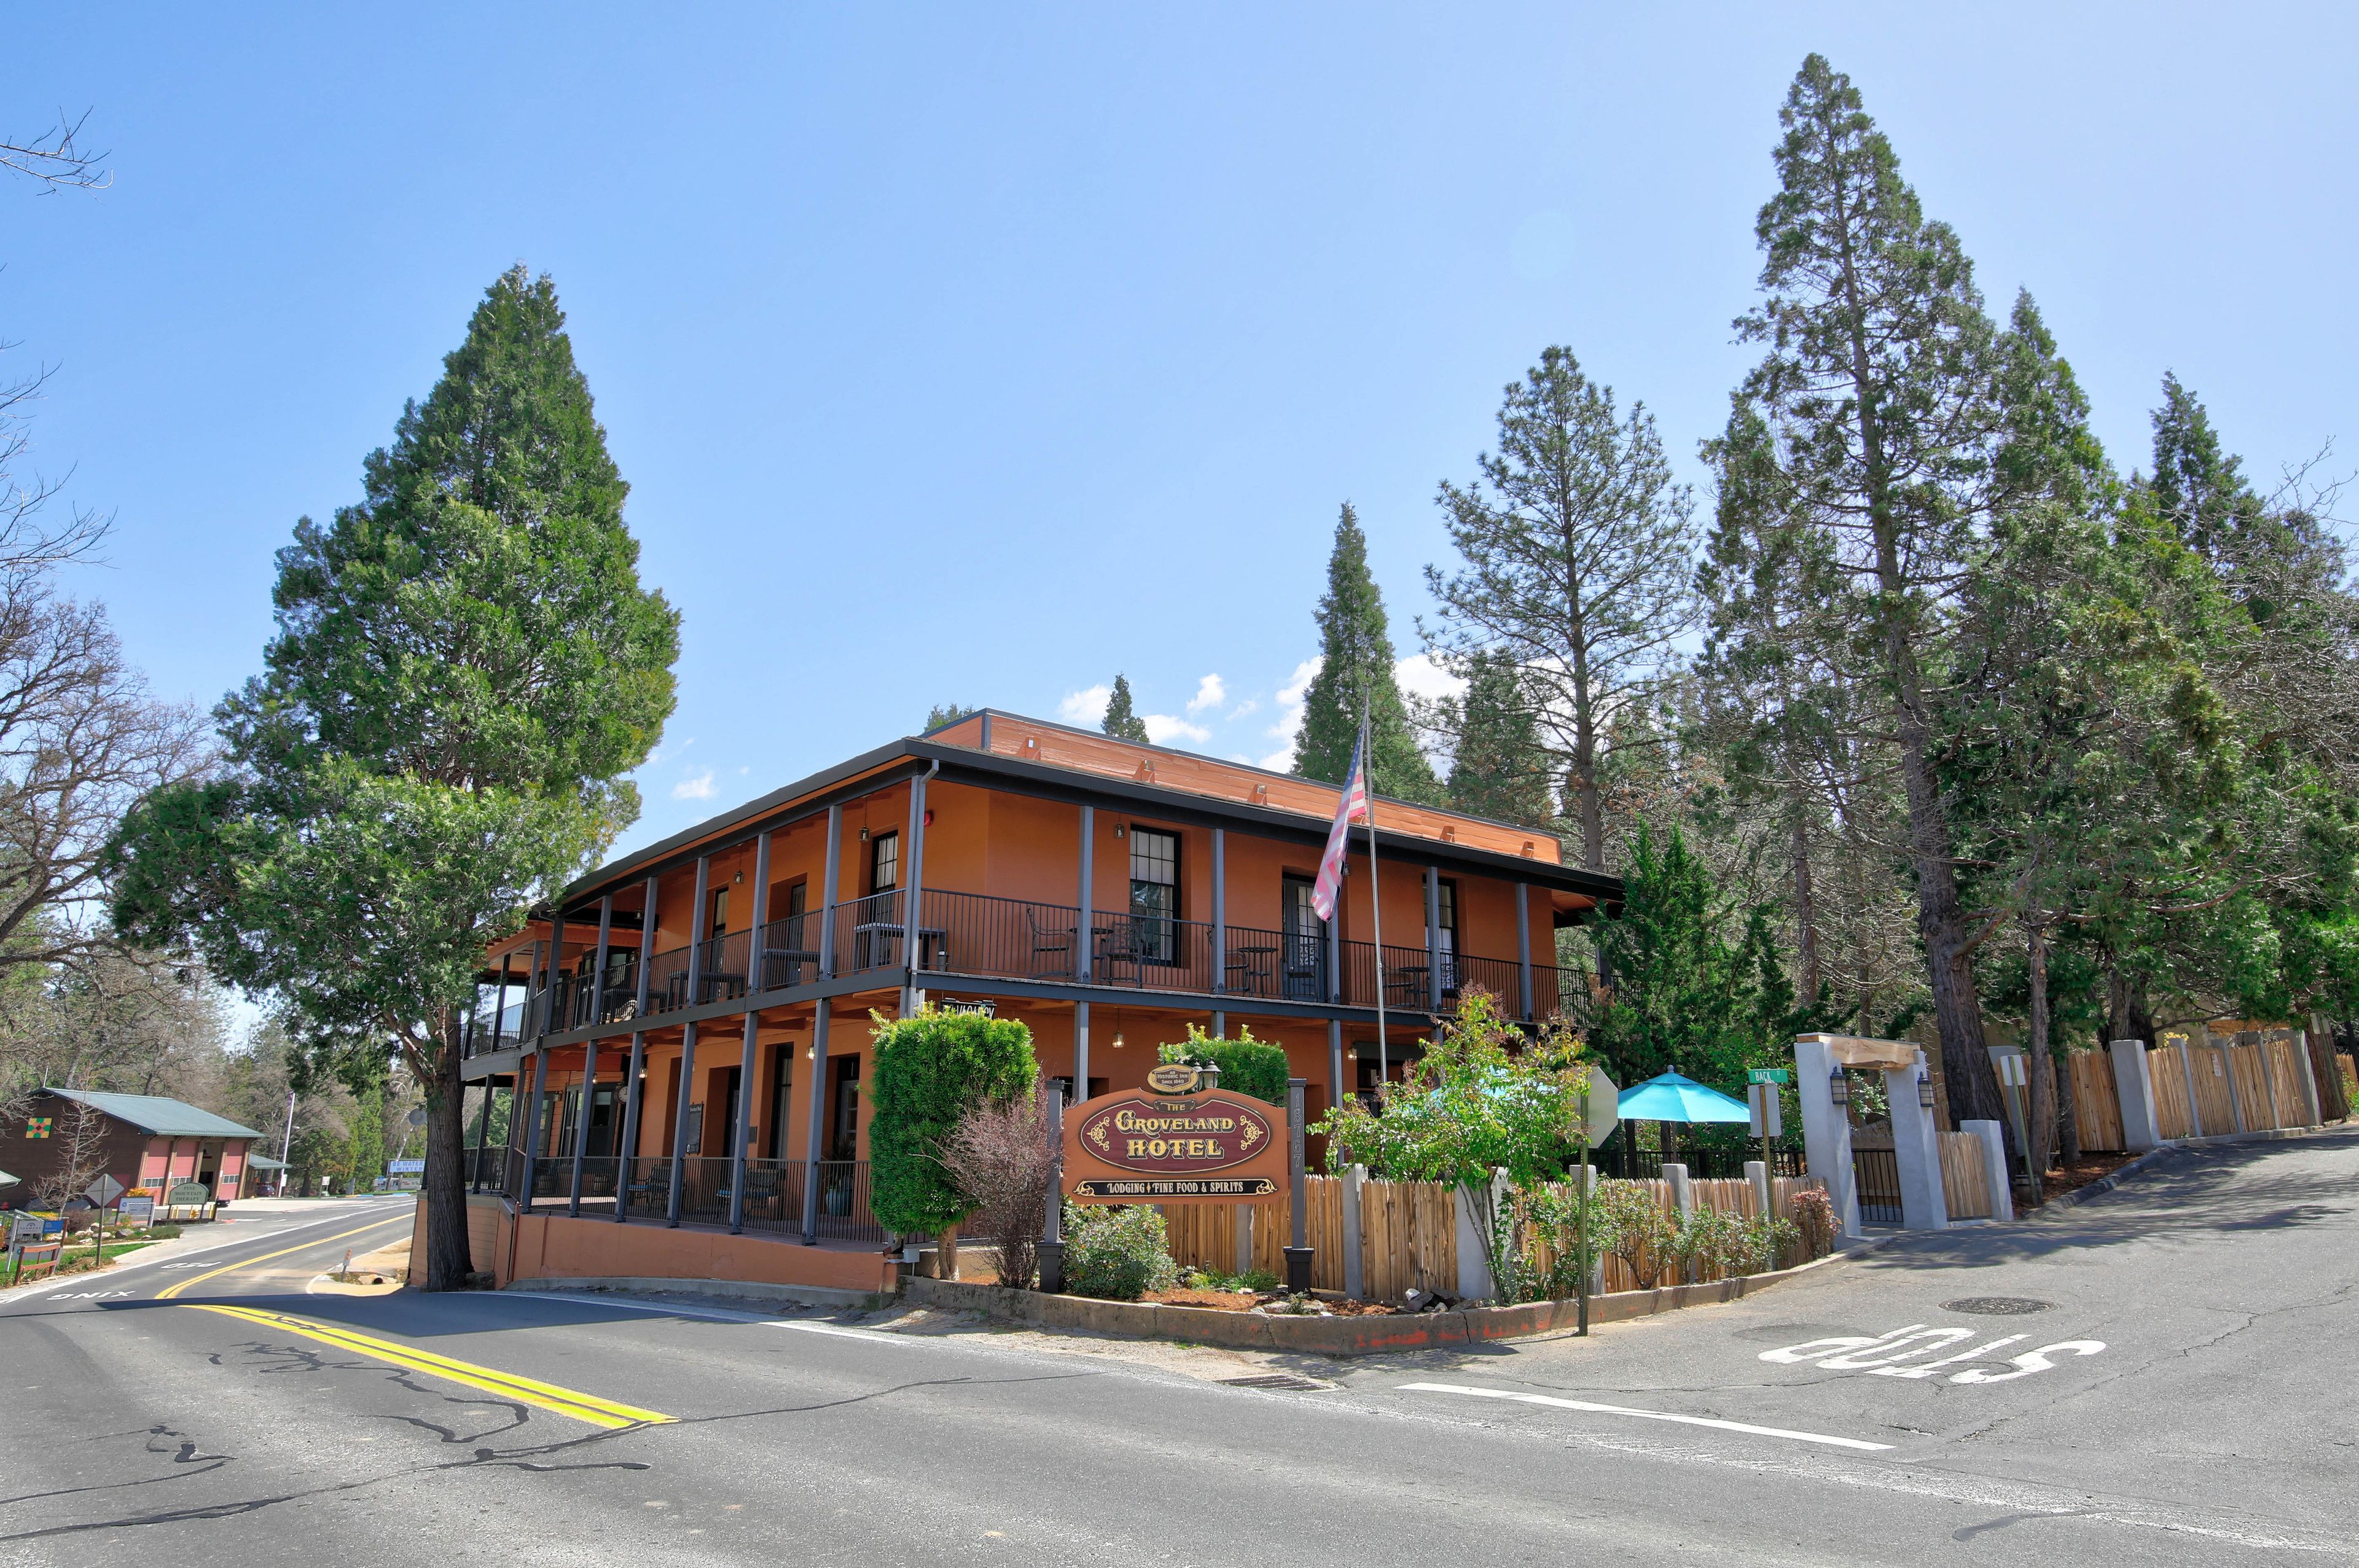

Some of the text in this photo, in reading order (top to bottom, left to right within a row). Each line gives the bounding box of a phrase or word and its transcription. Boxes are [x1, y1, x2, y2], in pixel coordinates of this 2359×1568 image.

[1755, 1071, 1772, 1082] BACK
[1160, 1102, 1186, 1111] THE
[1114, 1110, 1237, 1139] GROVELAND
[1293, 1093, 1302, 1168] 18767
[1127, 1139, 1225, 1160] HOTEL
[1107, 1182, 1243, 1193] LODGING FINE FOOD & SPIRITS
[47, 1290, 136, 1300] XING
[1757, 1324, 2107, 1384] STOP
